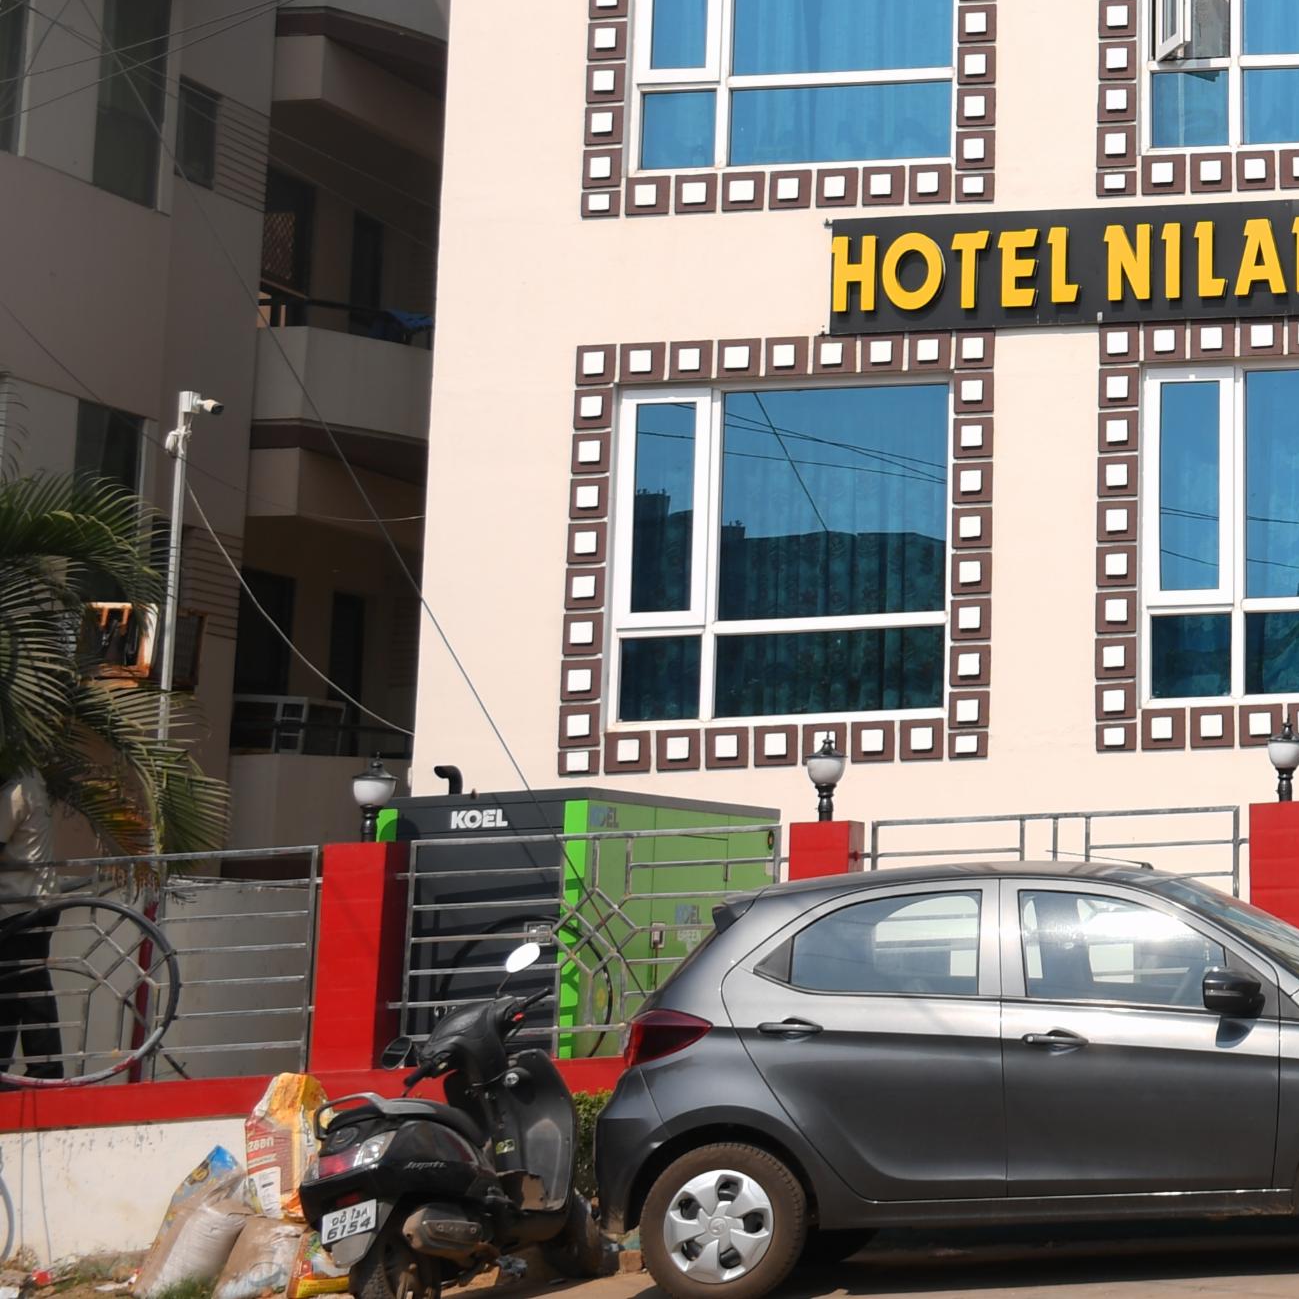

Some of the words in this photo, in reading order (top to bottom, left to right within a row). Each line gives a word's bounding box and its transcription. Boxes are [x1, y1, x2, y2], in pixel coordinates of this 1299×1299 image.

[831, 226, 1079, 312] HOTEL
[450, 808, 509, 829] KOEL
[327, 1217, 371, 1240] 6154
